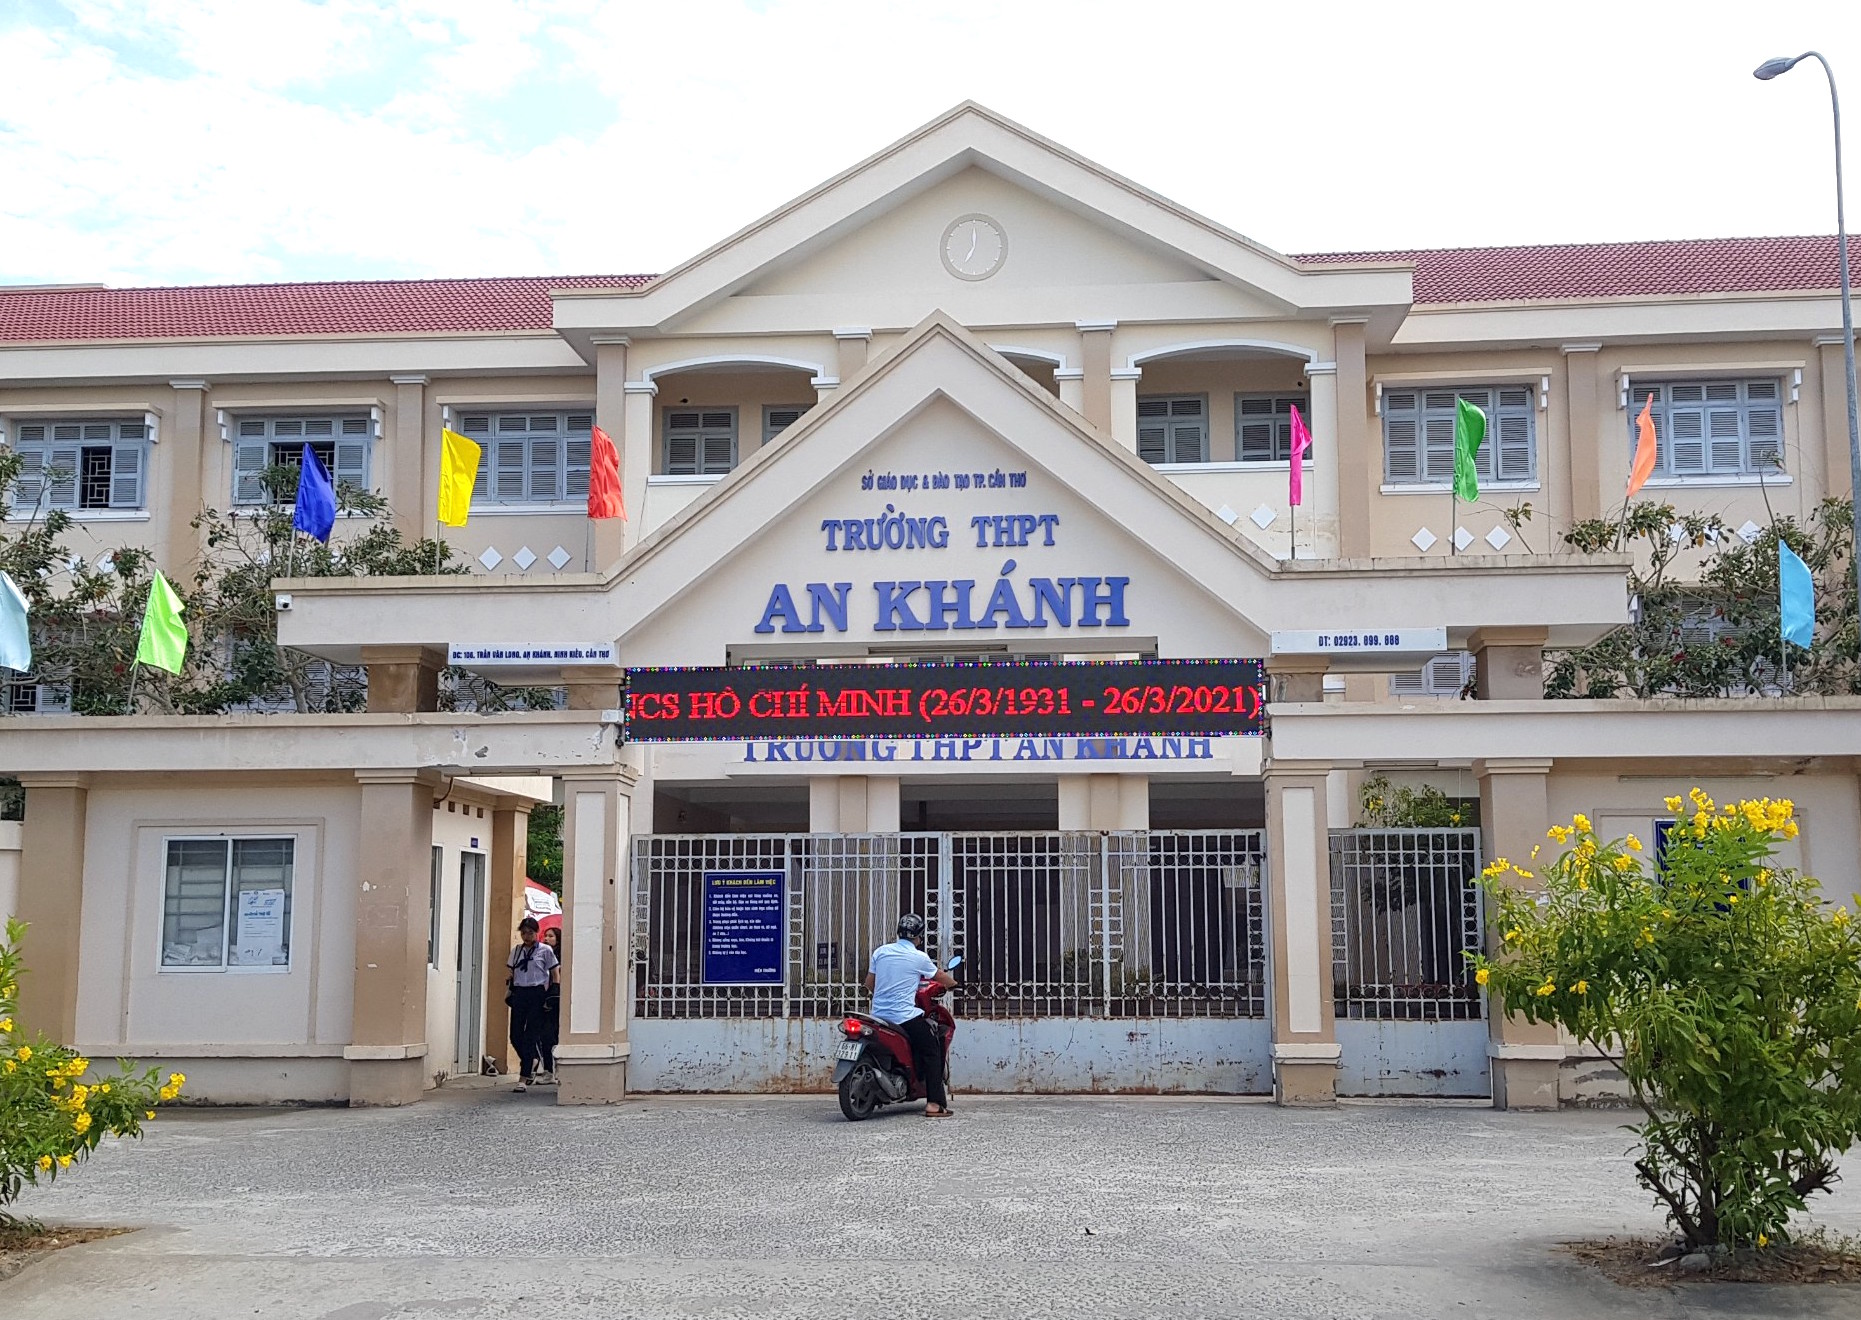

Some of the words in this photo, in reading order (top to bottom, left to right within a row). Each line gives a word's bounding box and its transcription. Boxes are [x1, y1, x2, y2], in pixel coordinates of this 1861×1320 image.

[861, 469, 875, 491] SỞ
[877, 471, 898, 491] GIÁO
[900, 474, 918, 493] DỤC
[922, 474, 930, 490] &
[953, 473, 970, 492] TẠO
[973, 473, 986, 489] TP.
[1009, 470, 1027, 488] THƠ
[821, 503, 950, 551] TRƯỜNG
[970, 514, 1060, 548] THPT
[754, 582, 852, 634] AN
[873, 558, 1130, 632] KHÁNH
[816, 689, 912, 717] MINH
[919, 687, 1073, 723] (26/3/1931
[1103, 685, 1261, 720] 26/3/2021)
